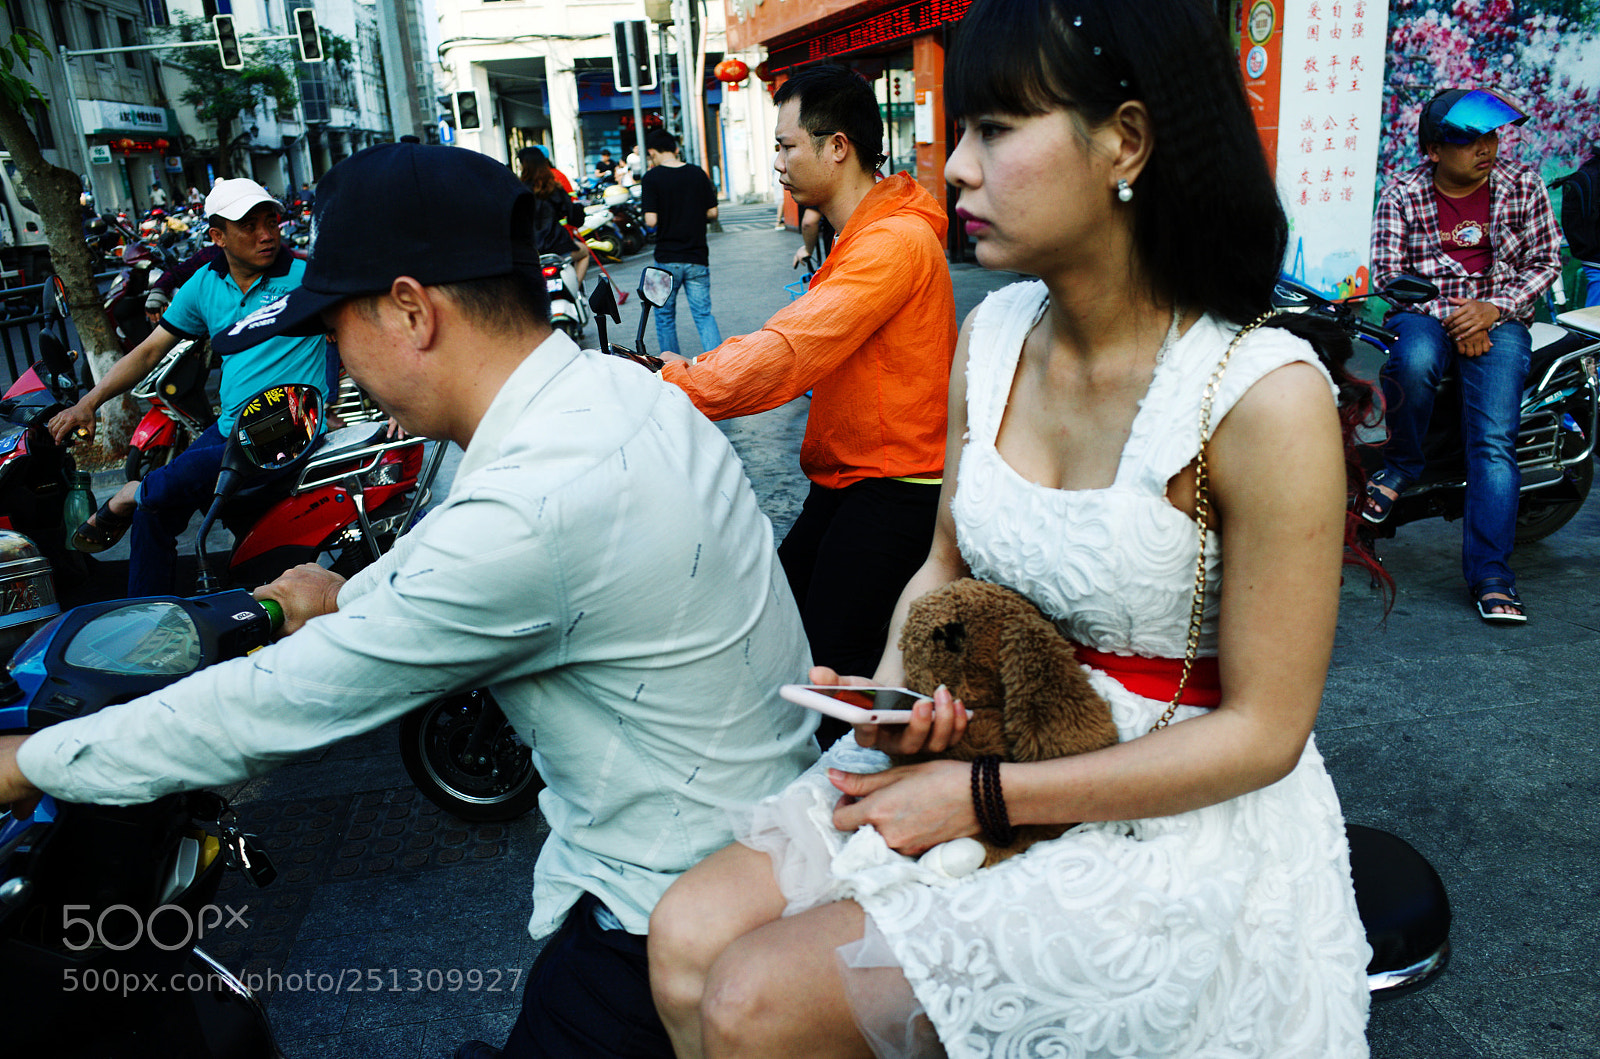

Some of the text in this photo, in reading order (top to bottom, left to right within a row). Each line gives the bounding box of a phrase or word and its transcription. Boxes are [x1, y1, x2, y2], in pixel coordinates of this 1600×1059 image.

[1302, 56, 1319, 93] 敬业
[1347, 55, 1364, 92] 民主
[1319, 1, 1342, 202] 自由 平等 公正 法治
[1300, 115, 1317, 153] 诚信
[1344, 113, 1360, 151] 文明
[1296, 166, 1313, 205] 友善
[1340, 166, 1356, 202] 和谐
